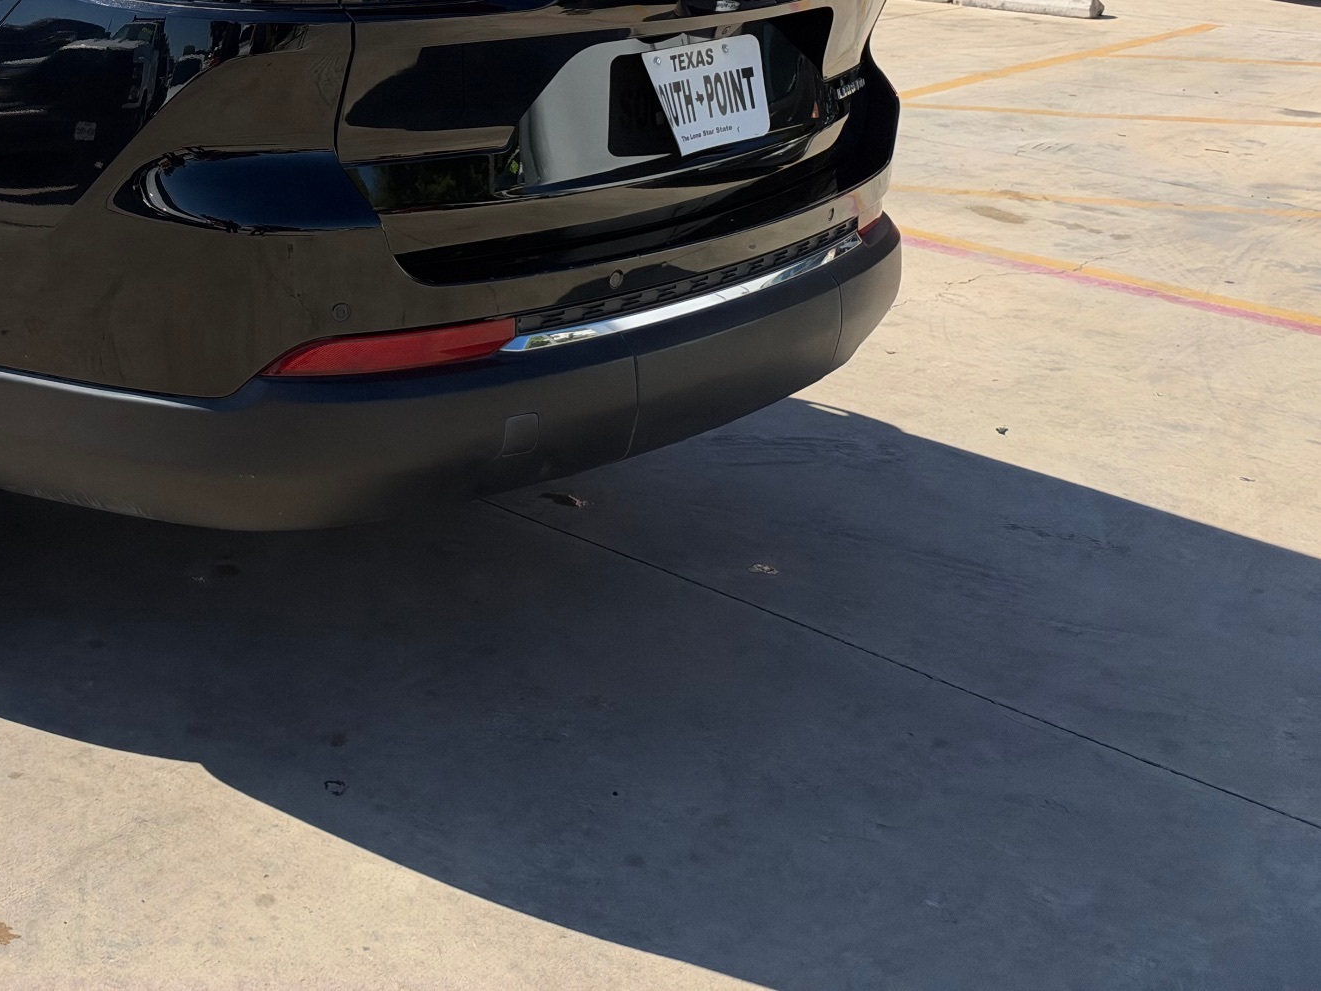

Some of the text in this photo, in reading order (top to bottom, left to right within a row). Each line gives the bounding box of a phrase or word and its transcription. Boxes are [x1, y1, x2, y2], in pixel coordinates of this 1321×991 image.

[669, 48, 714, 72] TEXAS
[703, 66, 756, 118] POINT
[703, 128, 715, 137] Star
